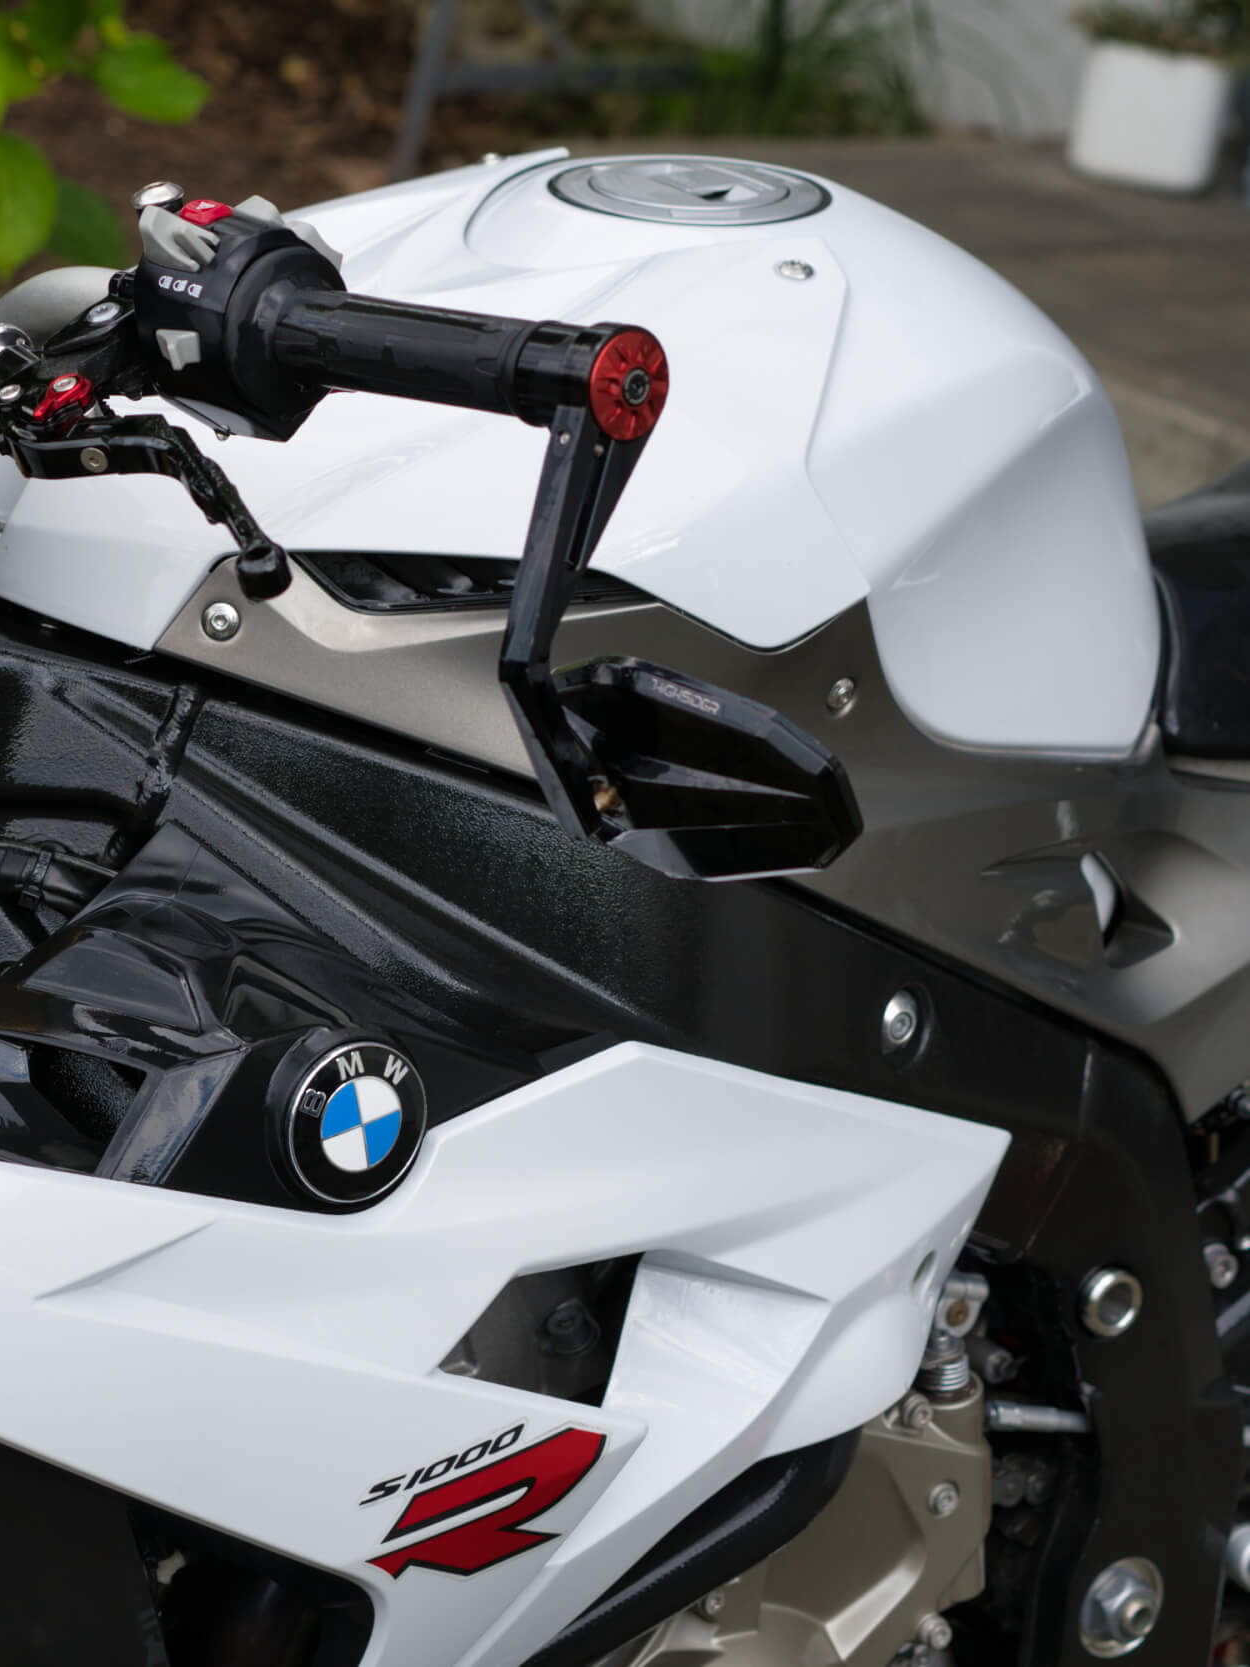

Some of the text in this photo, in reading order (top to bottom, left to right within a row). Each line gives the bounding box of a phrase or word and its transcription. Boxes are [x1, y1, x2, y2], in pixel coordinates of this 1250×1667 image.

[302, 1050, 409, 1118] BMW
[358, 1423, 525, 1506] S1000
[364, 1427, 607, 1580] R
